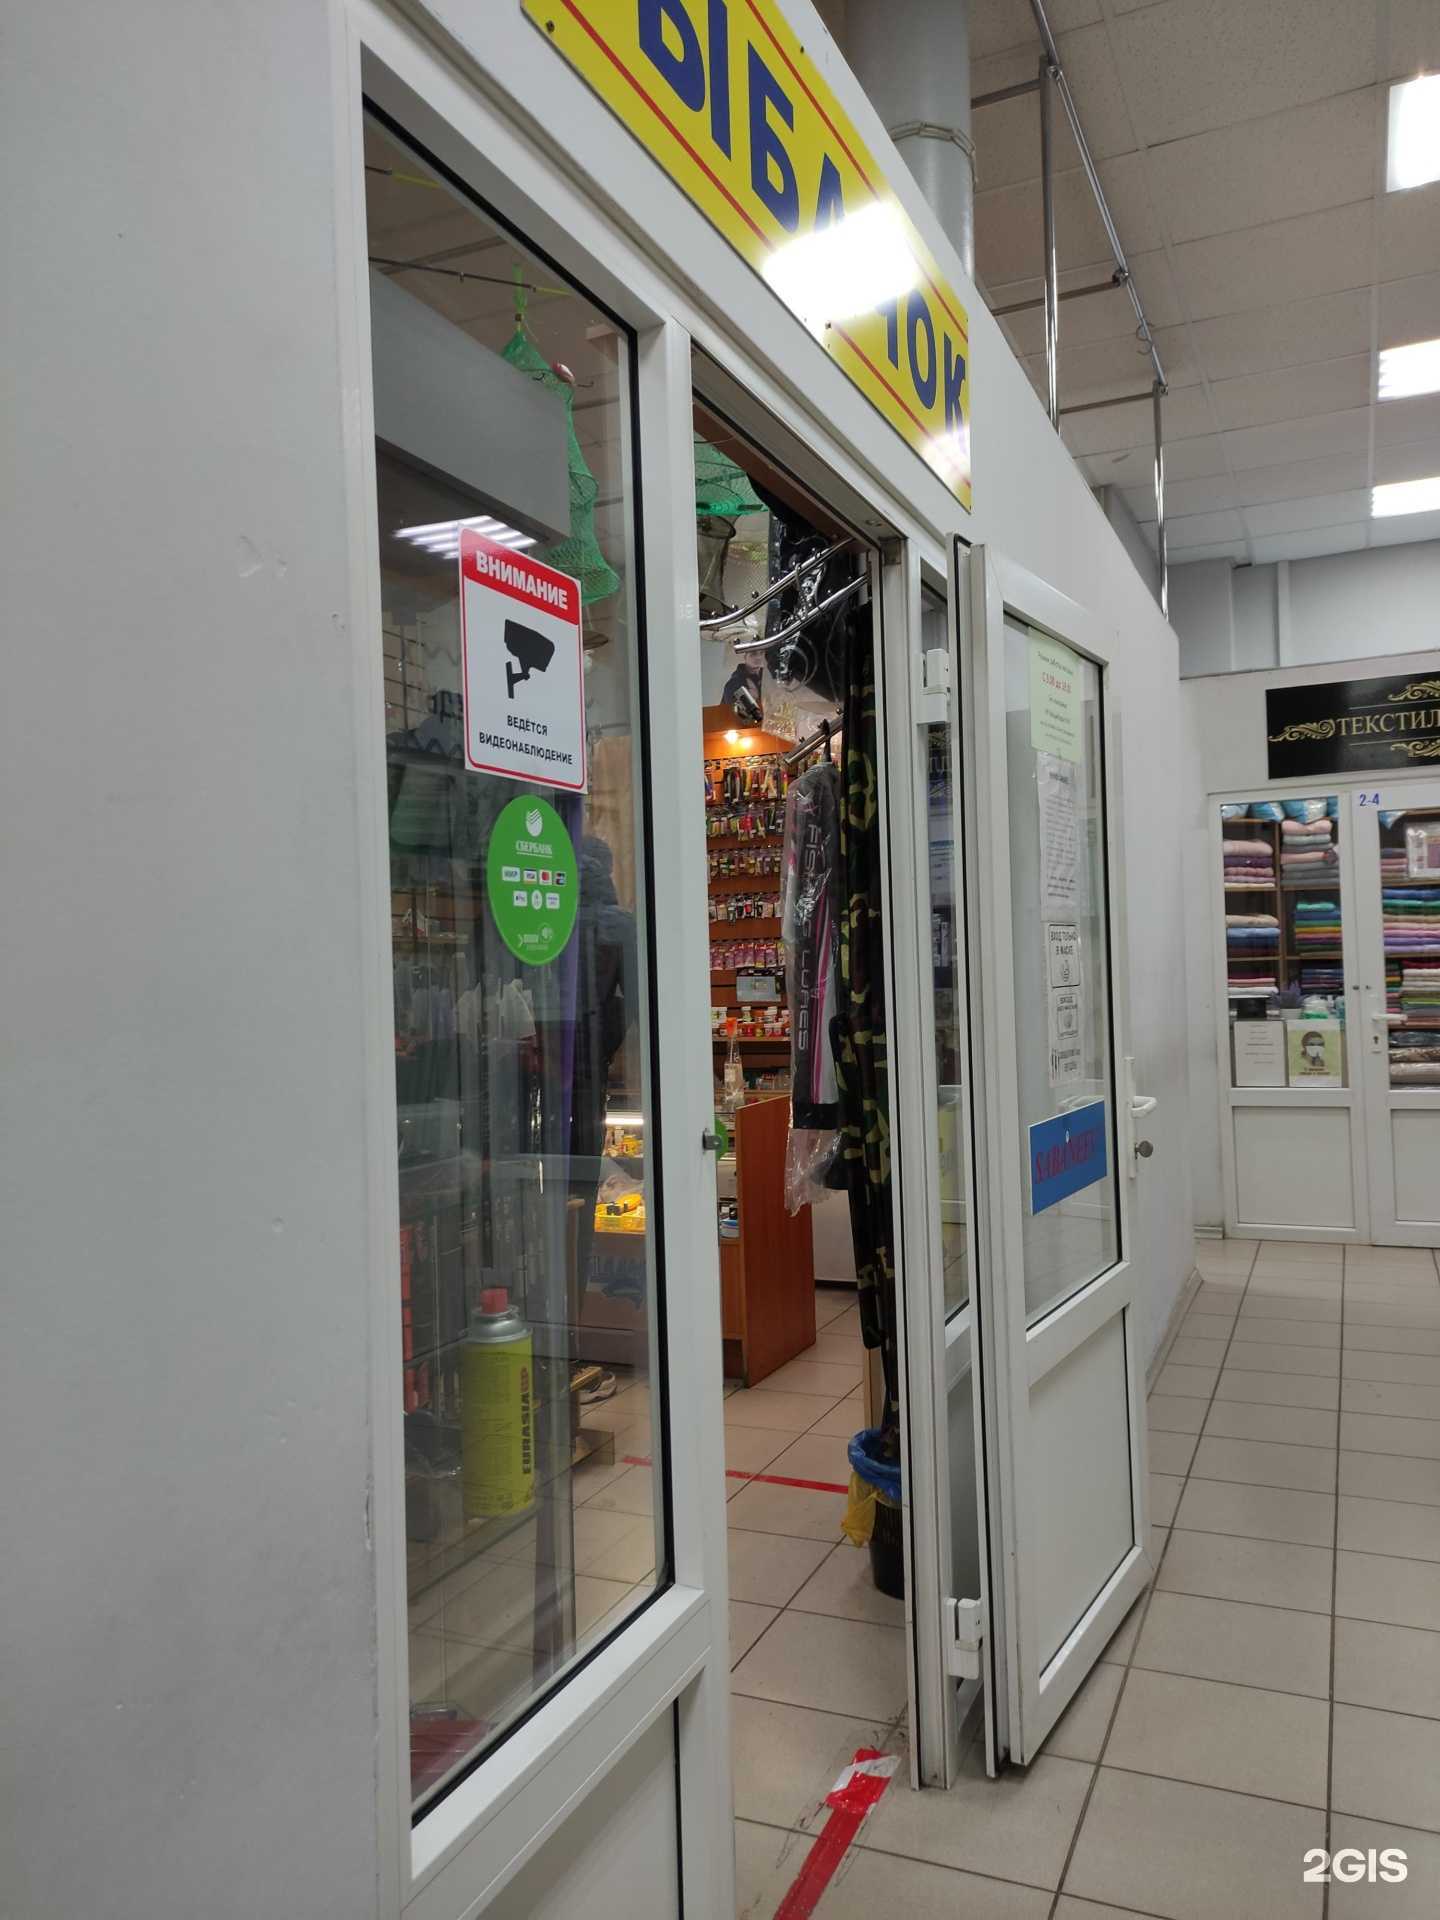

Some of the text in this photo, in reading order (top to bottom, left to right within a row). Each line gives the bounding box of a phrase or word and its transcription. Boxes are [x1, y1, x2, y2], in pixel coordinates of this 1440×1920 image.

[475, 550, 568, 610] ВНИМАНИЕ
[1337, 709, 1440, 736] ТЕКСТИЛ
[479, 731, 573, 765] ВИДЕОНАБЛЮДЕНИЕ
[1359, 793, 1380, 807] 2-4
[802, 823, 818, 939] FISG
